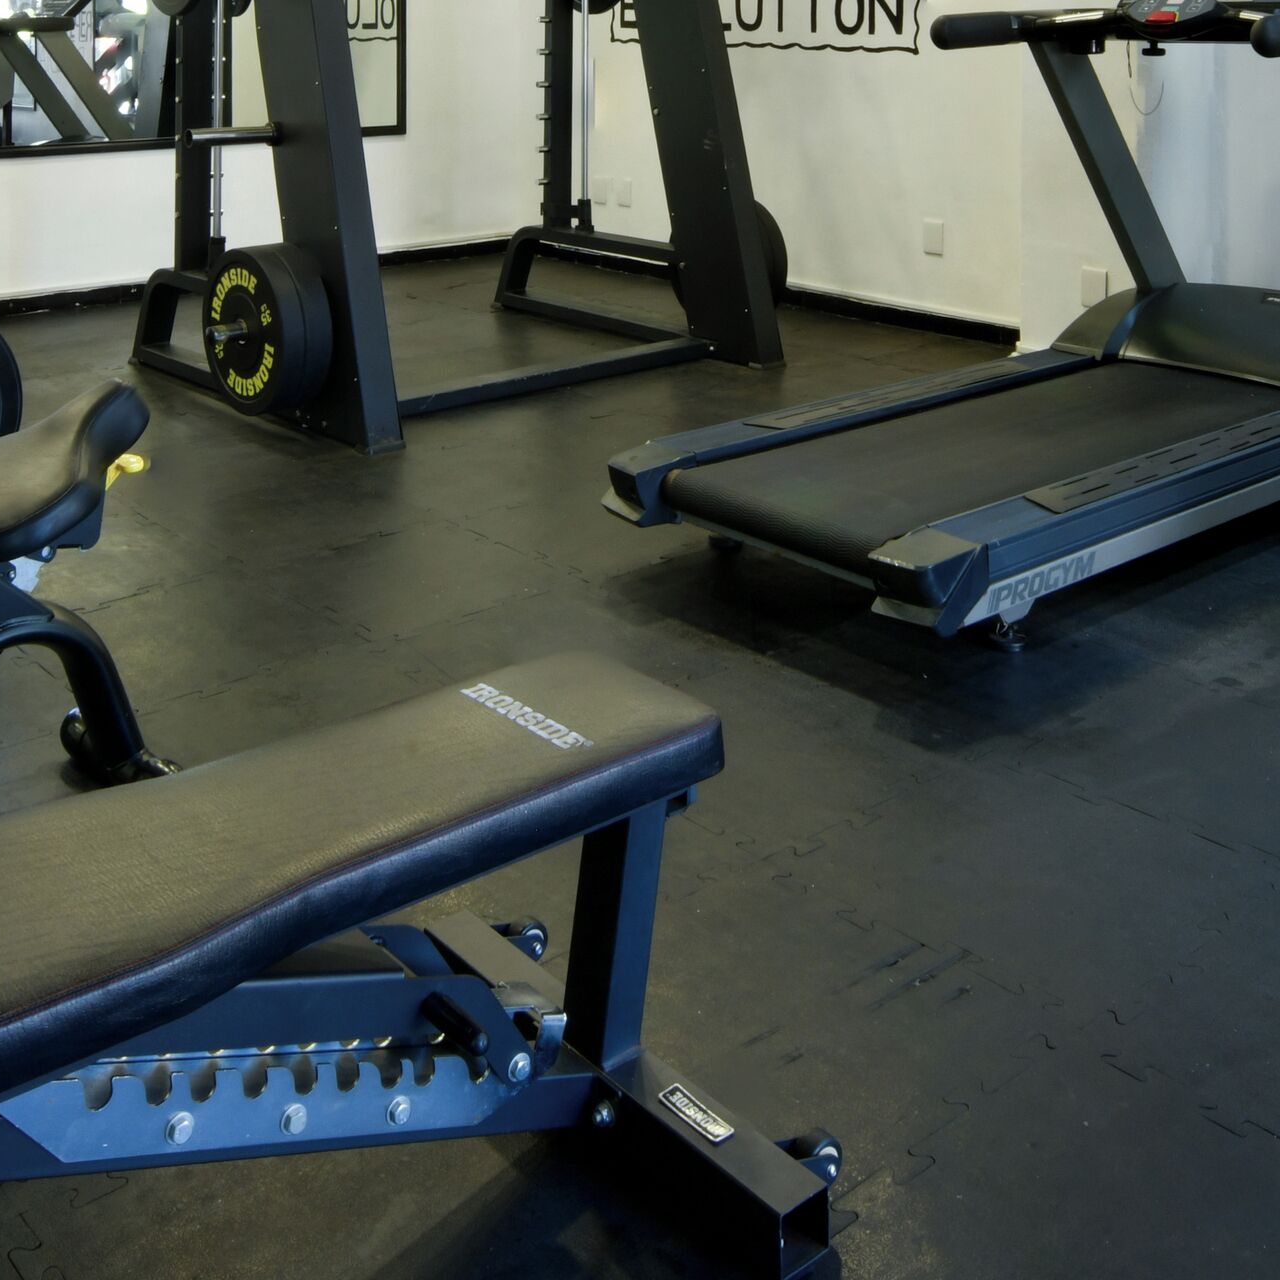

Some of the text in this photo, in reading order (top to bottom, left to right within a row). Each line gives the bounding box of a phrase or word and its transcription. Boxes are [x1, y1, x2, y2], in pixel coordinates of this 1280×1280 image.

[211, 267, 257, 321] IRONSIDE
[227, 343, 275, 397] IRONSIDE
[994, 551, 1097, 610] PROGYM
[460, 682, 585, 750] IRONSIDE
